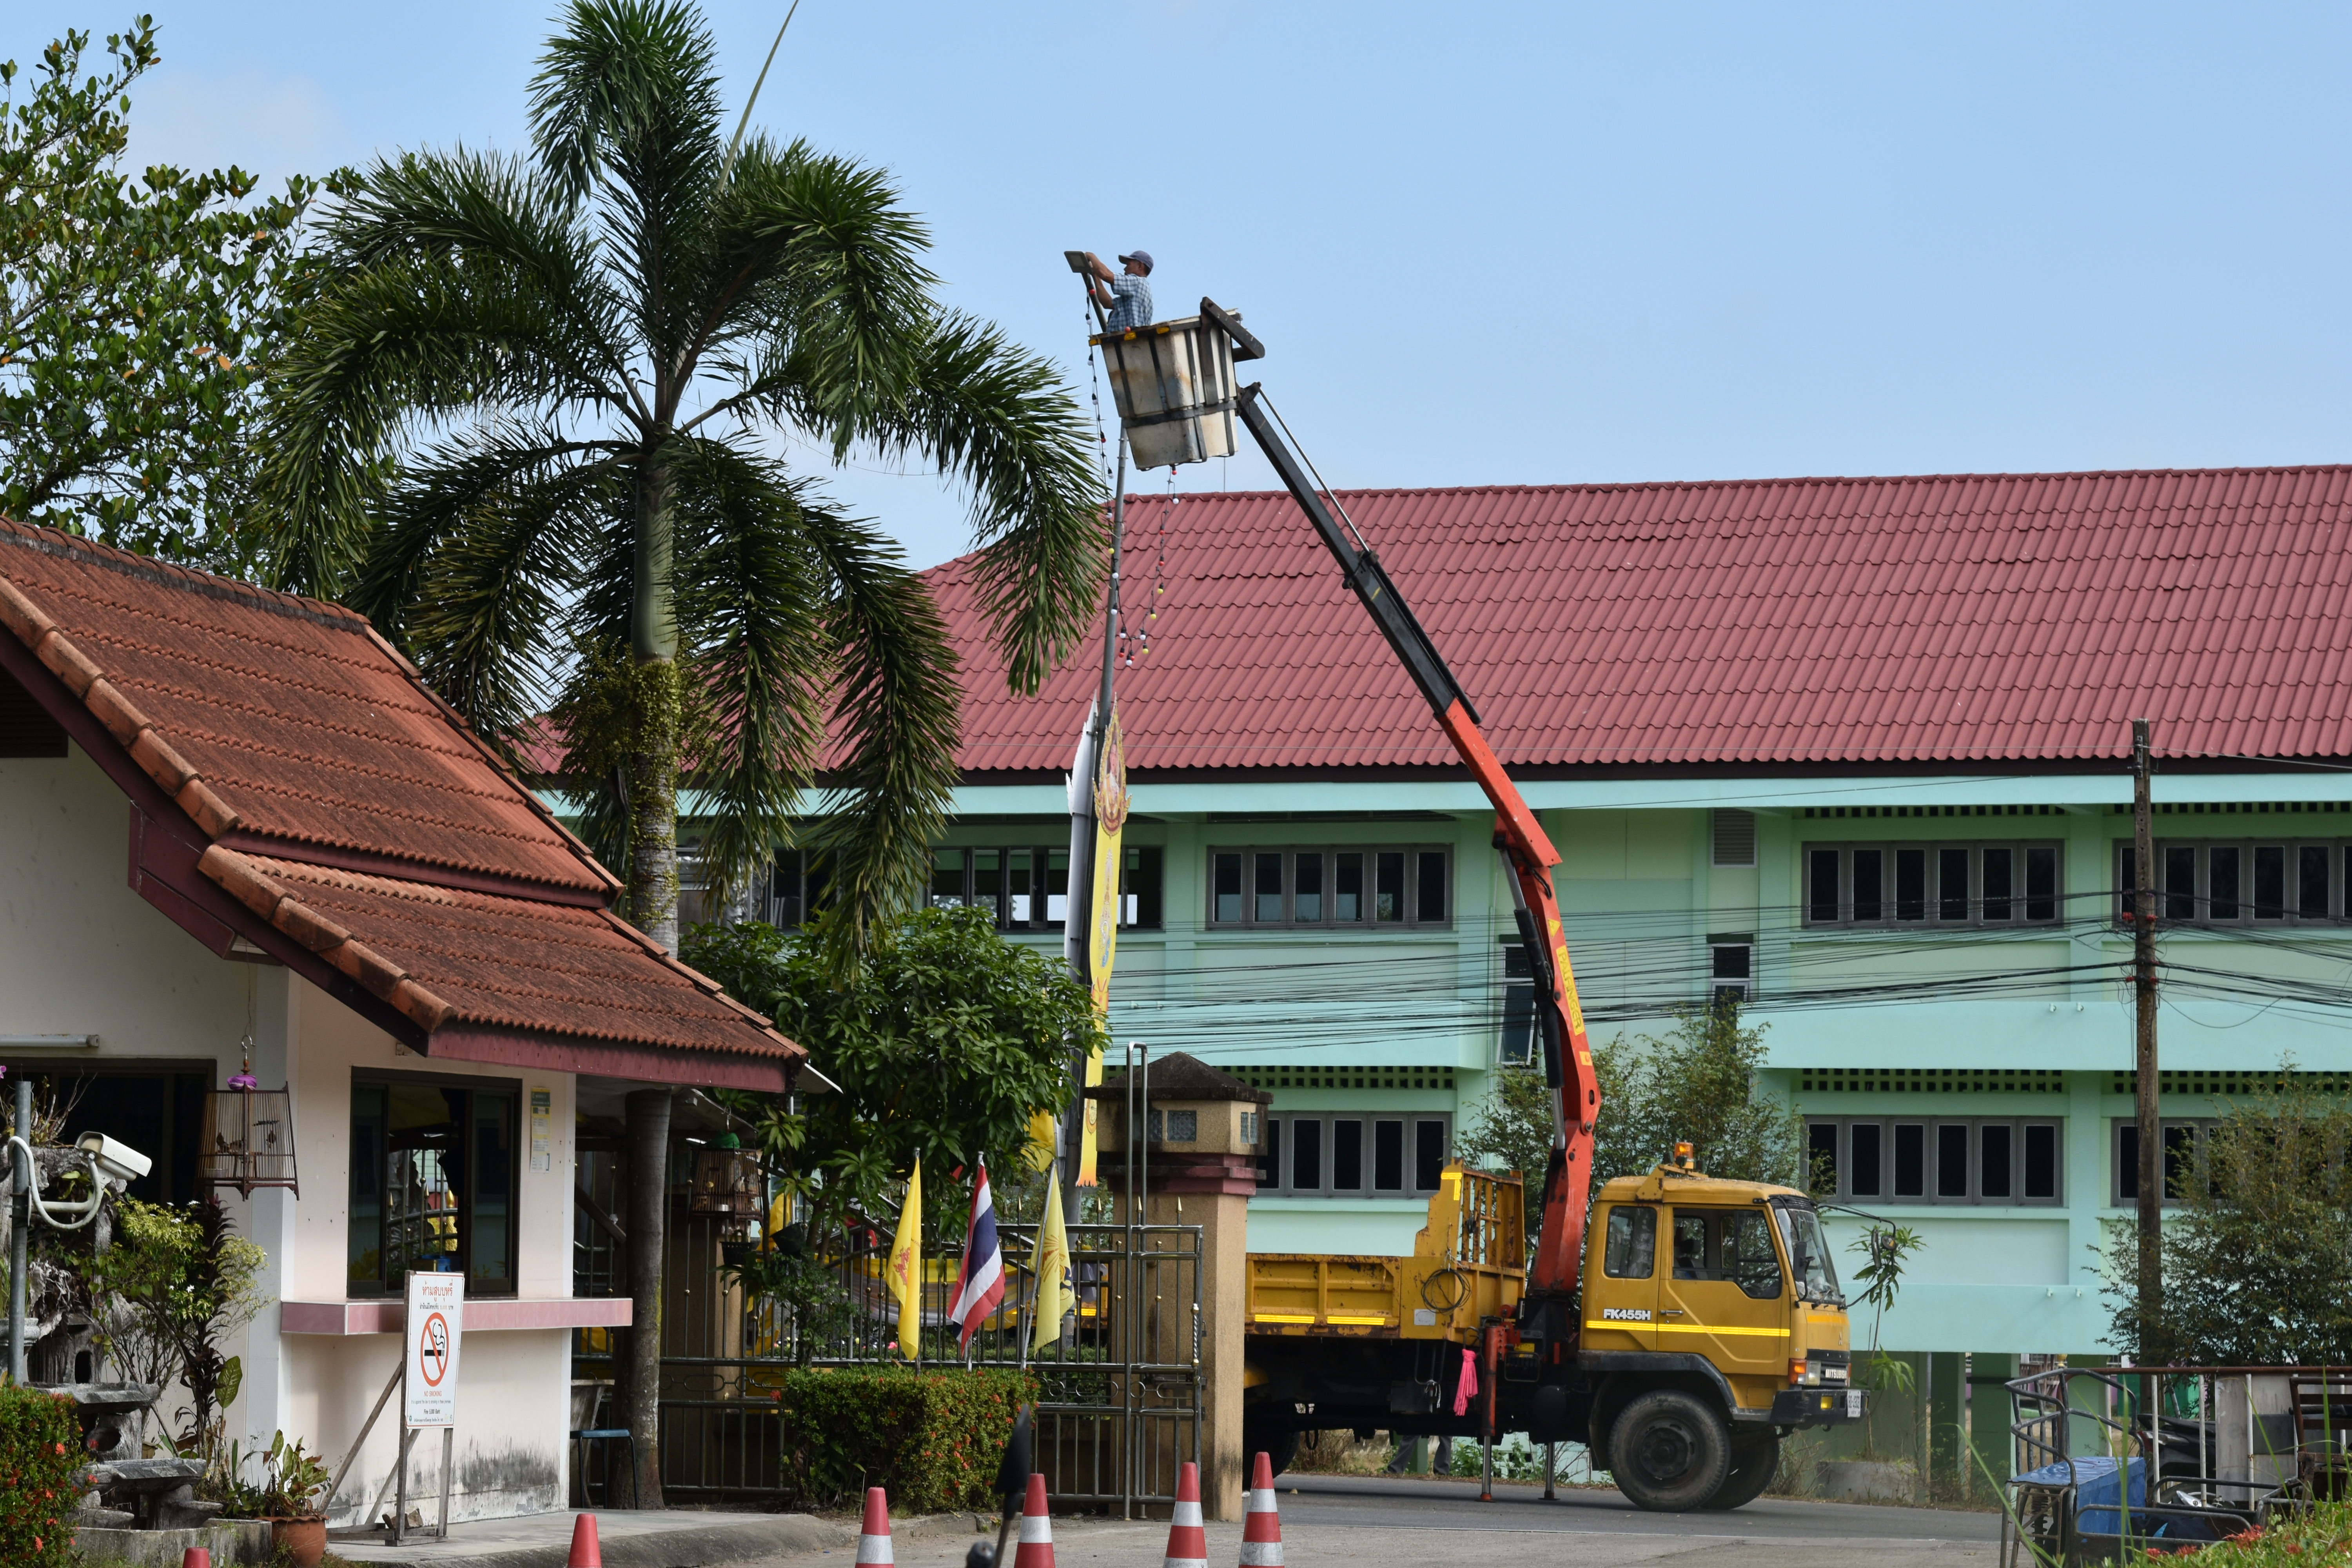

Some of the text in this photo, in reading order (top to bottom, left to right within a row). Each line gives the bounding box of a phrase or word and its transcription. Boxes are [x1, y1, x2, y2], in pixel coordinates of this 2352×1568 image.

[1559, 951, 1582, 1030] PALFINGER
[422, 1278, 453, 1302] ห้ามสูบบุหรี่
[1603, 1308, 1651, 1321] FK455H
